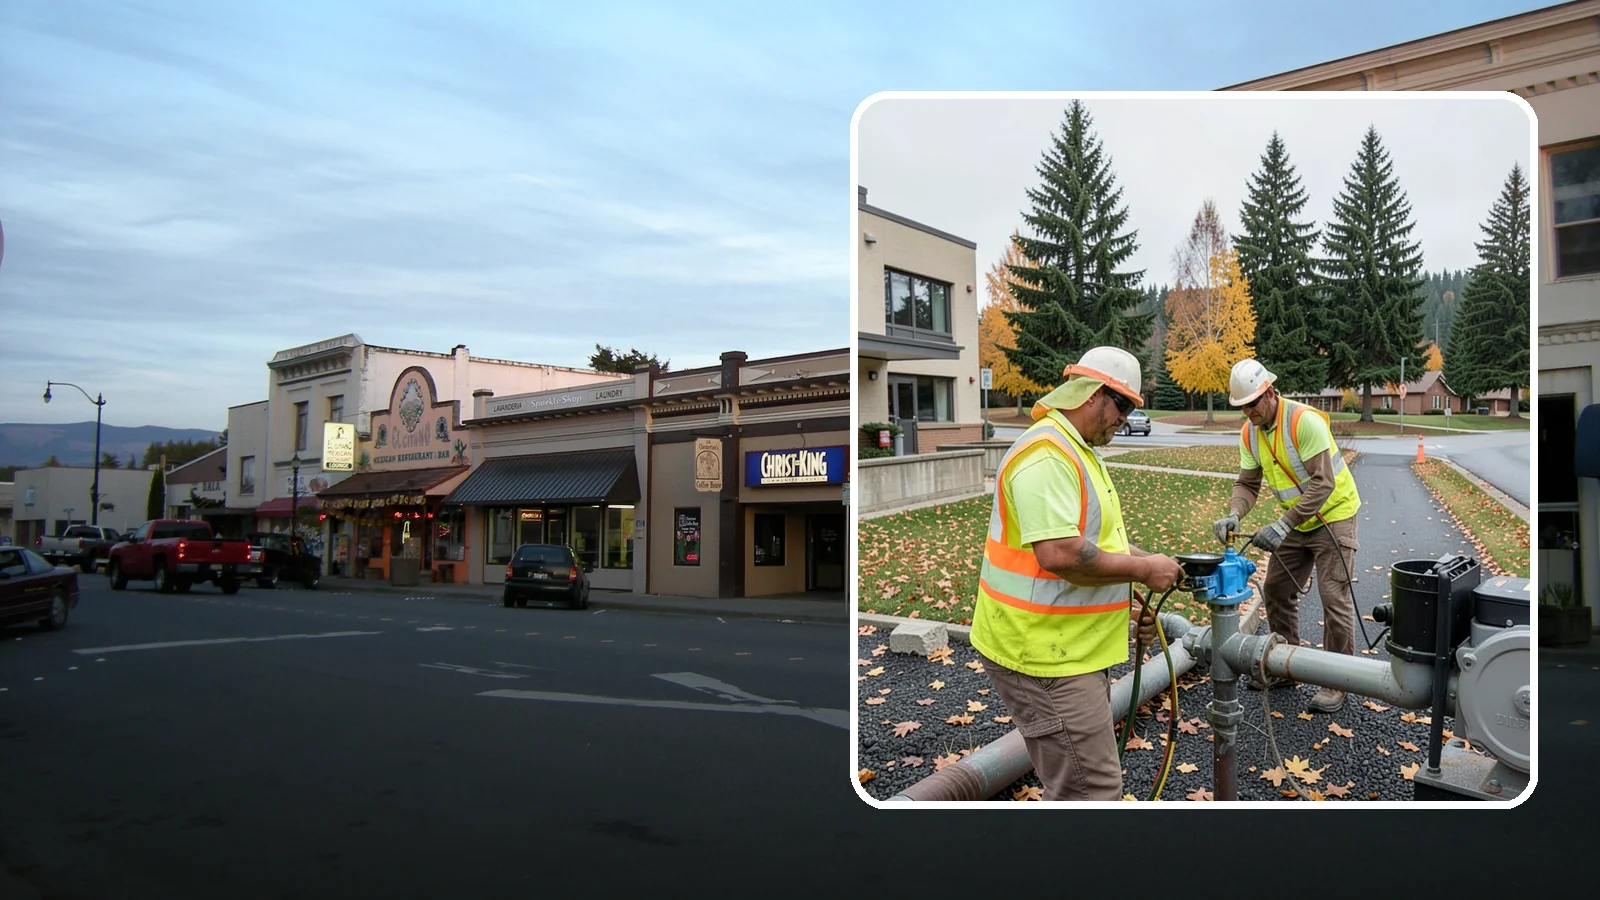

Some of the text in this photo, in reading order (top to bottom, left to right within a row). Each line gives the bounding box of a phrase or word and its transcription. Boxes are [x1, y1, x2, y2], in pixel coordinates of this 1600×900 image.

[493, 388, 623, 412] LAVANDERIA Sparkle Shop LAUNDRY
[373, 455, 396, 464] MEXICAN
[398, 451, 433, 462] RESTAURANT
[438, 450, 450, 459] BAR
[761, 450, 827, 478] CHRIST KING
